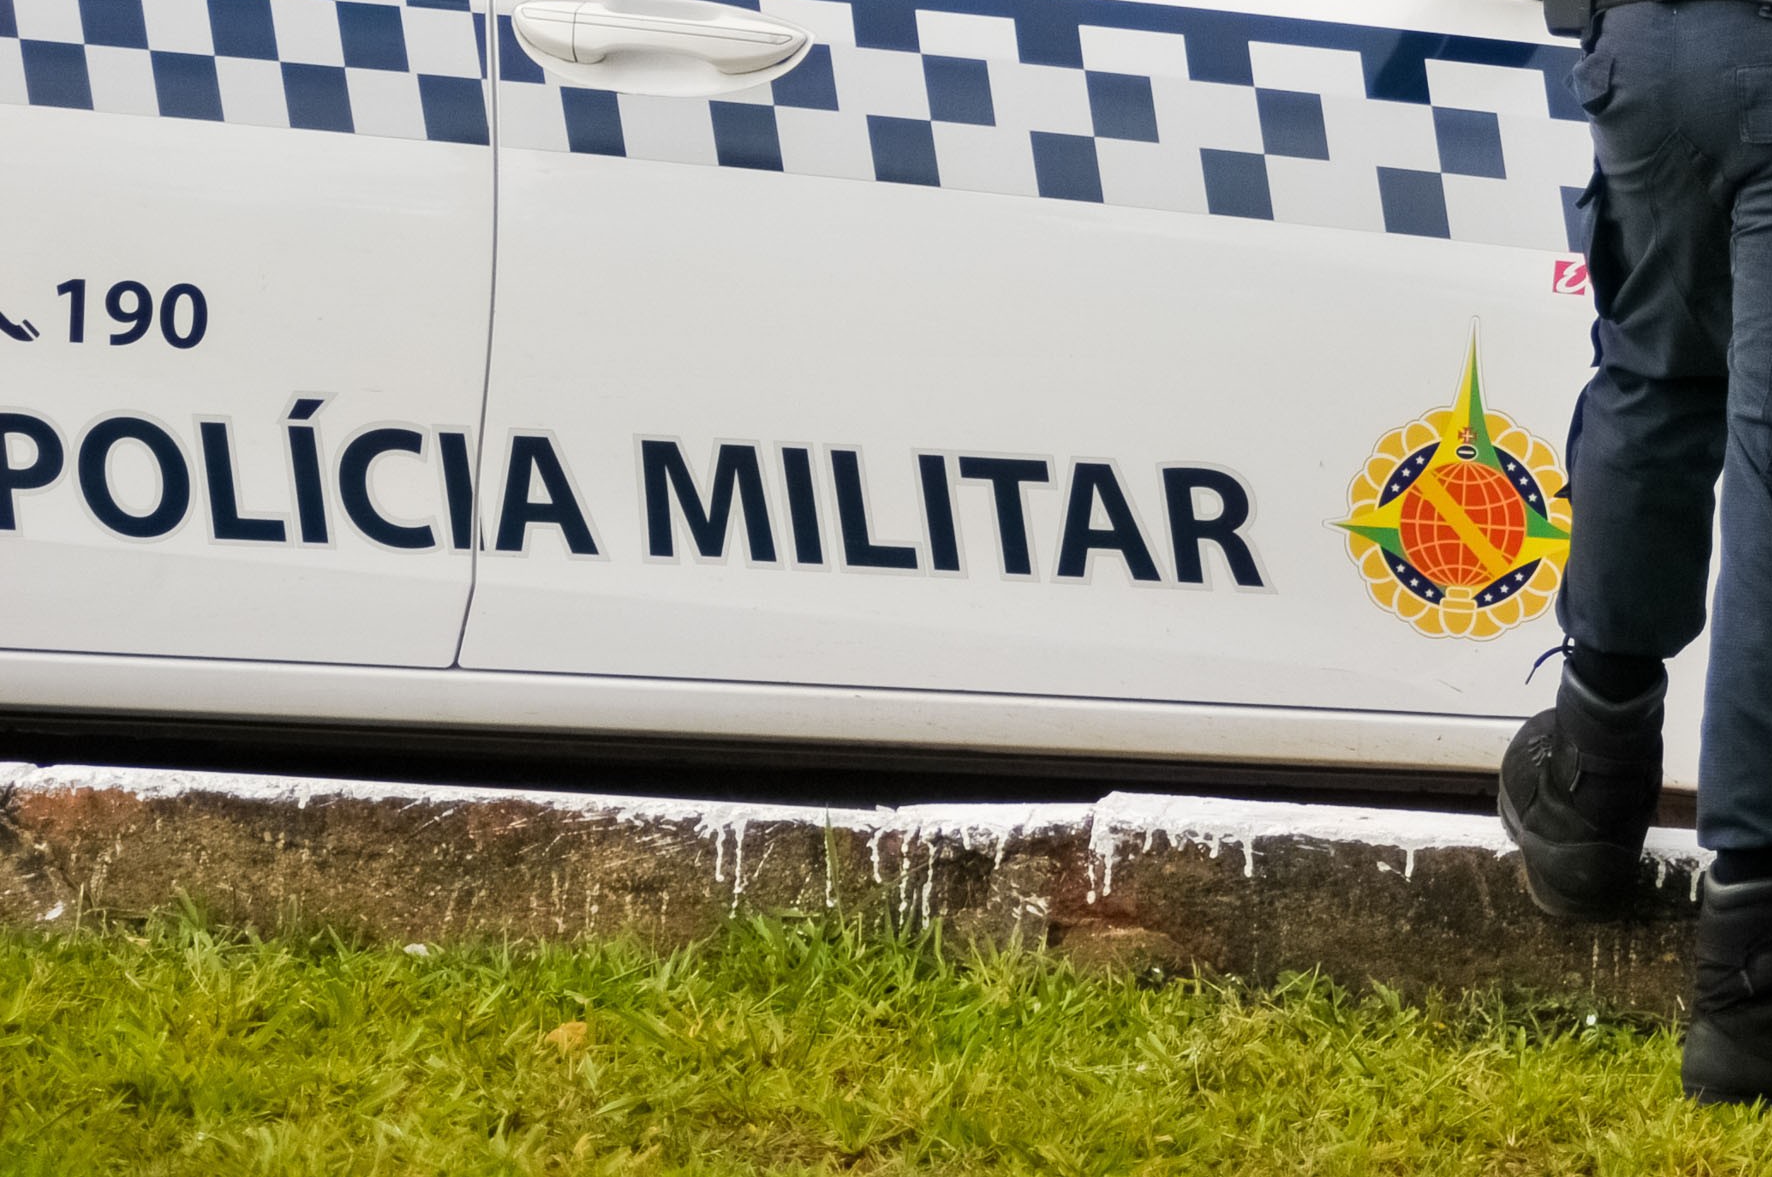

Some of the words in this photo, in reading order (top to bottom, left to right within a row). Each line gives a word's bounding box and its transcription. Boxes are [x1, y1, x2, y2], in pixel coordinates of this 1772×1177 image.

[56, 278, 208, 349] 190
[0, 398, 599, 555] POLÍCIA
[641, 440, 1264, 587] MILITAR
